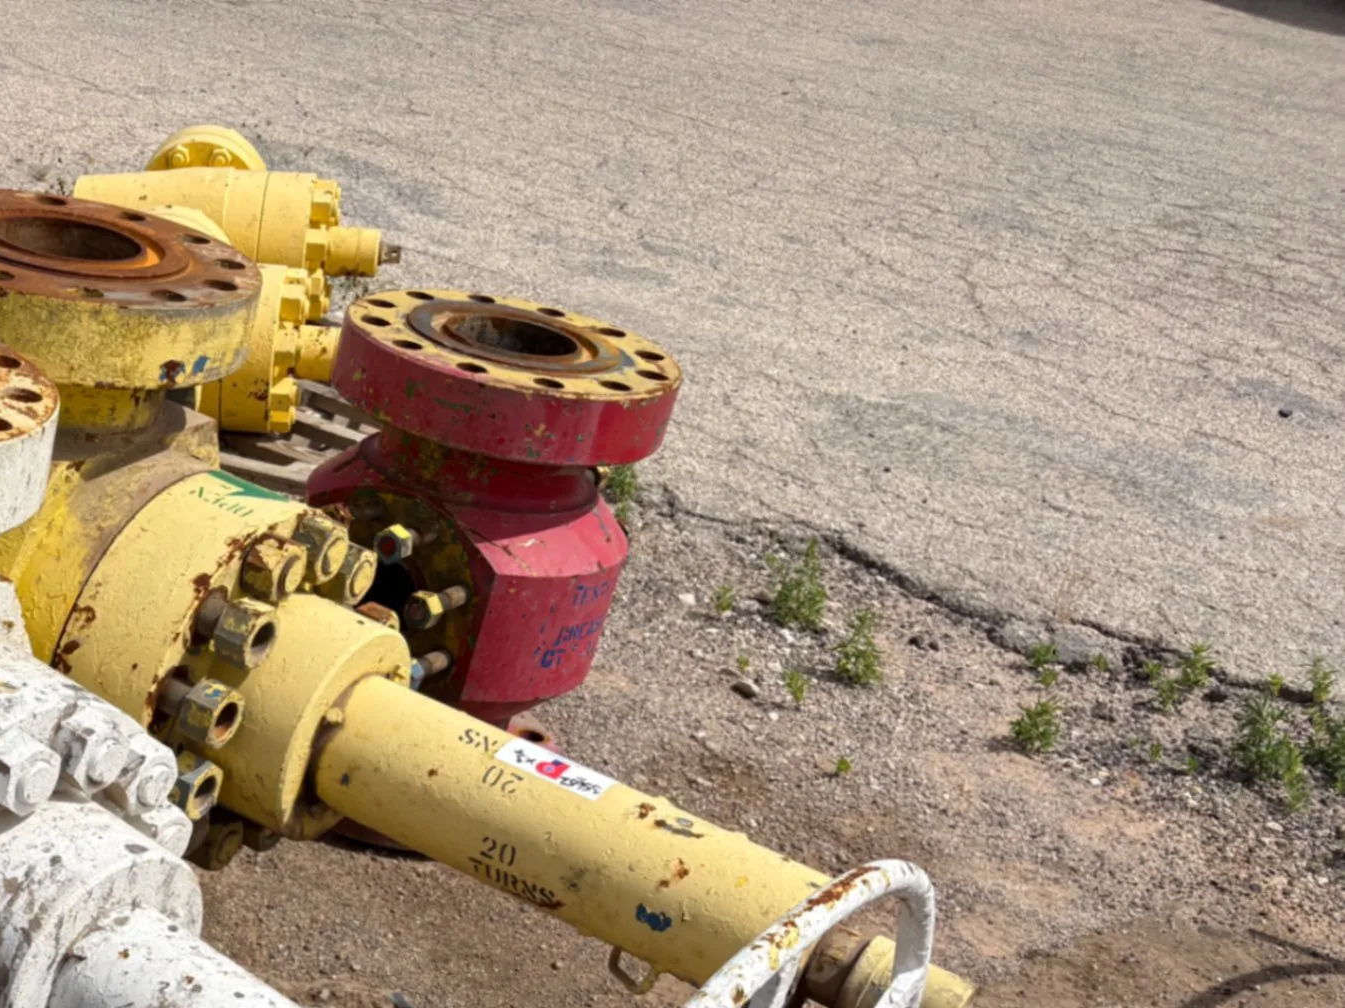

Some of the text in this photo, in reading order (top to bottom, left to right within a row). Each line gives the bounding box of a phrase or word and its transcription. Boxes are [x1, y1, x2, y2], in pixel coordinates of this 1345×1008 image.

[482, 765, 524, 794] 20
[480, 836, 516, 867] 20
[468, 856, 556, 906] TURNS
